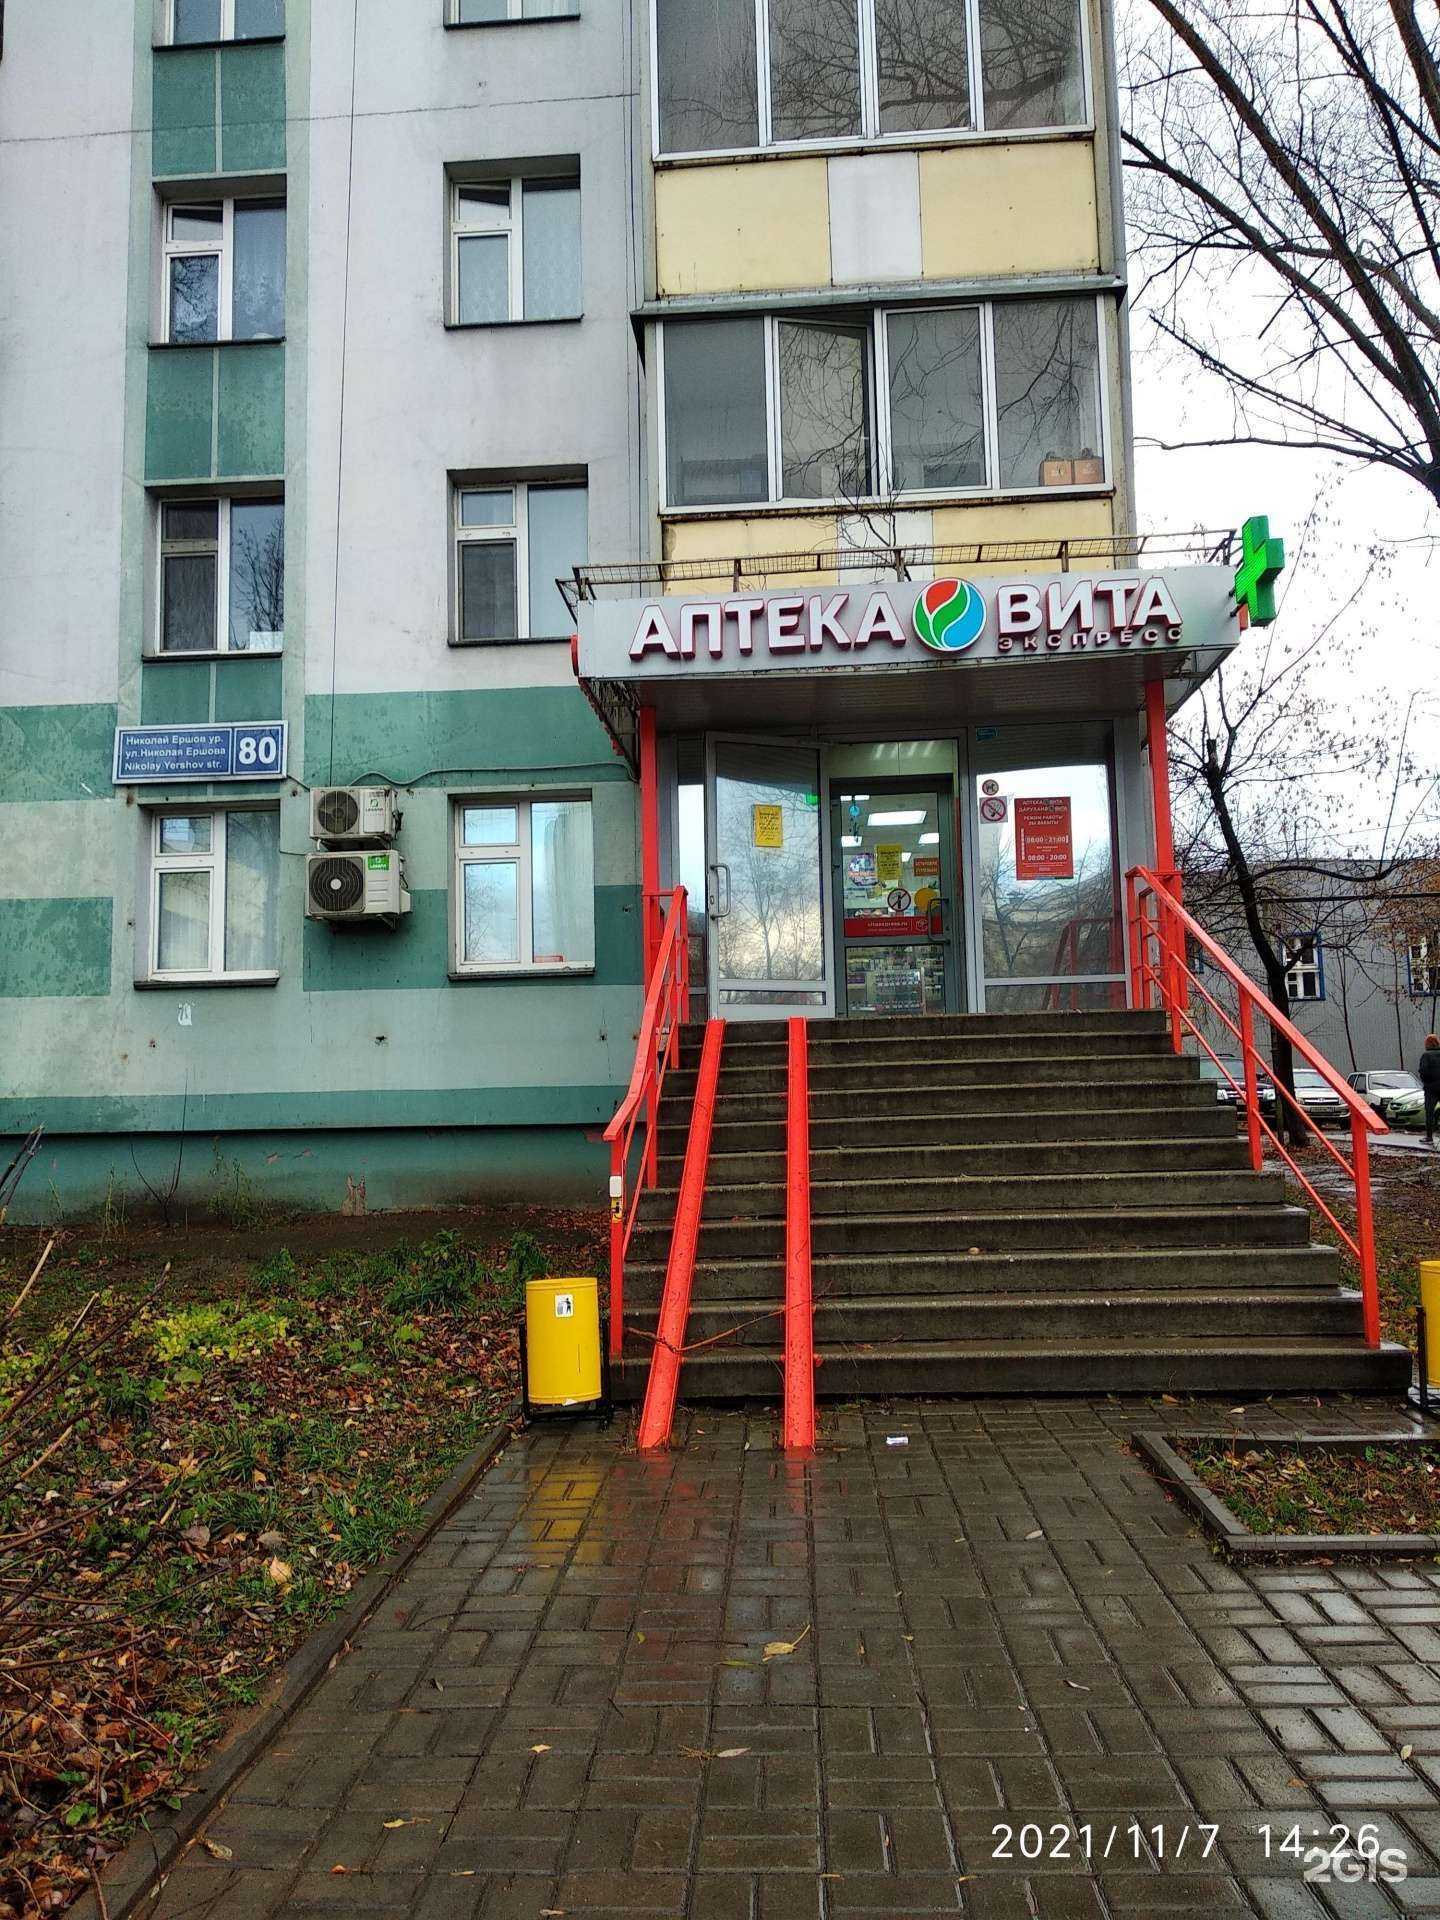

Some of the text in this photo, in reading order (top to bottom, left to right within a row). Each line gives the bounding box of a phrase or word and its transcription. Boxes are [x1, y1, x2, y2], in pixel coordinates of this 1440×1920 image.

[629, 575, 1182, 660] АПТЕКА ВИТА
[997, 626, 1183, 652] ЭКСПРЕСС
[126, 735, 224, 746] Николай Ершов ур.
[125, 747, 226, 758] ул.Николая Ершова
[238, 736, 277, 765] 80
[125, 760, 222, 772] Nikolay Yershov str.
